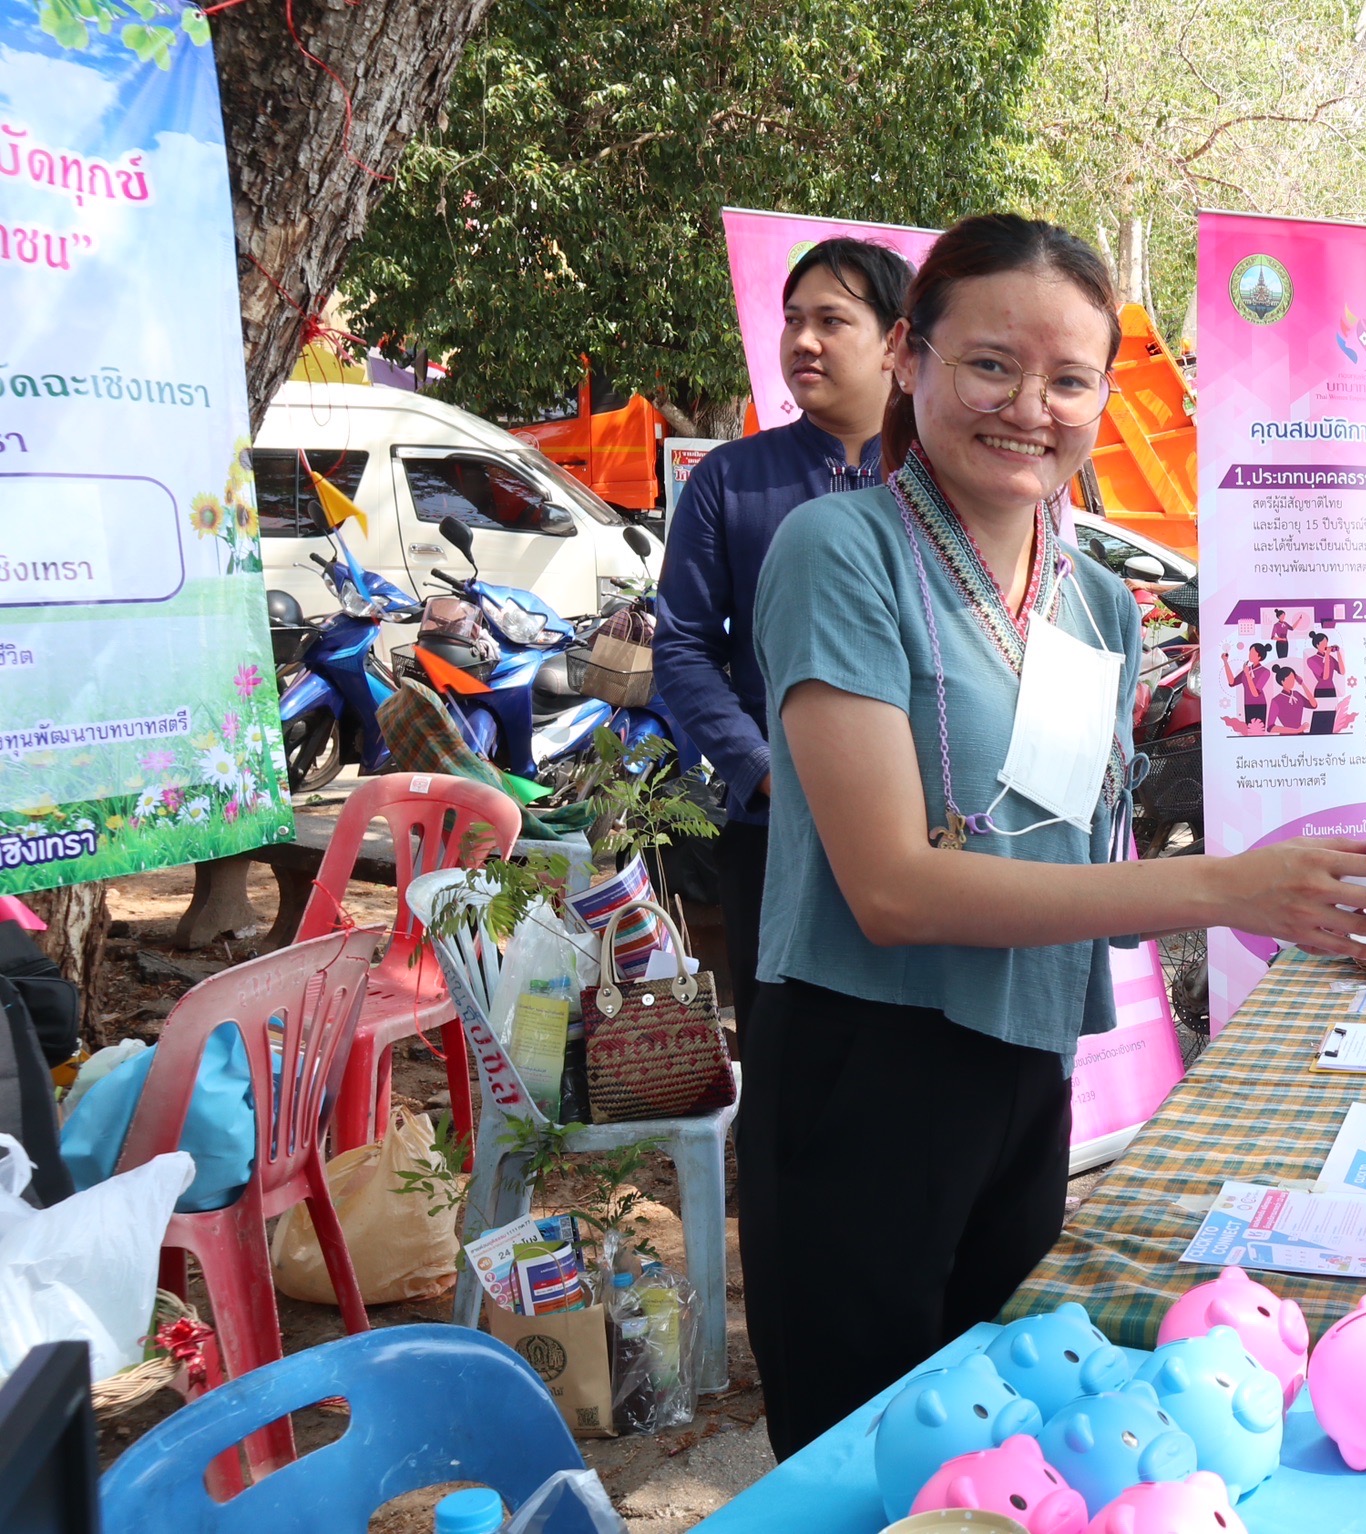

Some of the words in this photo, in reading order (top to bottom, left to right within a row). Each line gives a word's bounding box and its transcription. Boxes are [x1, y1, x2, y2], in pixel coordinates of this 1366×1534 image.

[1252, 495, 1343, 512] สตรีผู้มีสัญชาติไทย
[1253, 520, 1301, 533] และมีอายุ
[1306, 521, 1318, 530] 15
[1236, 751, 1346, 770] มีผลงานเป็นที่ประจักษ์
[1236, 774, 1327, 789] พัฒนาบทบาทสตรี
[1202, 1226, 1219, 1240] TO
[1212, 1221, 1242, 1255] CONNECT
[498, 1249, 511, 1261] 24
